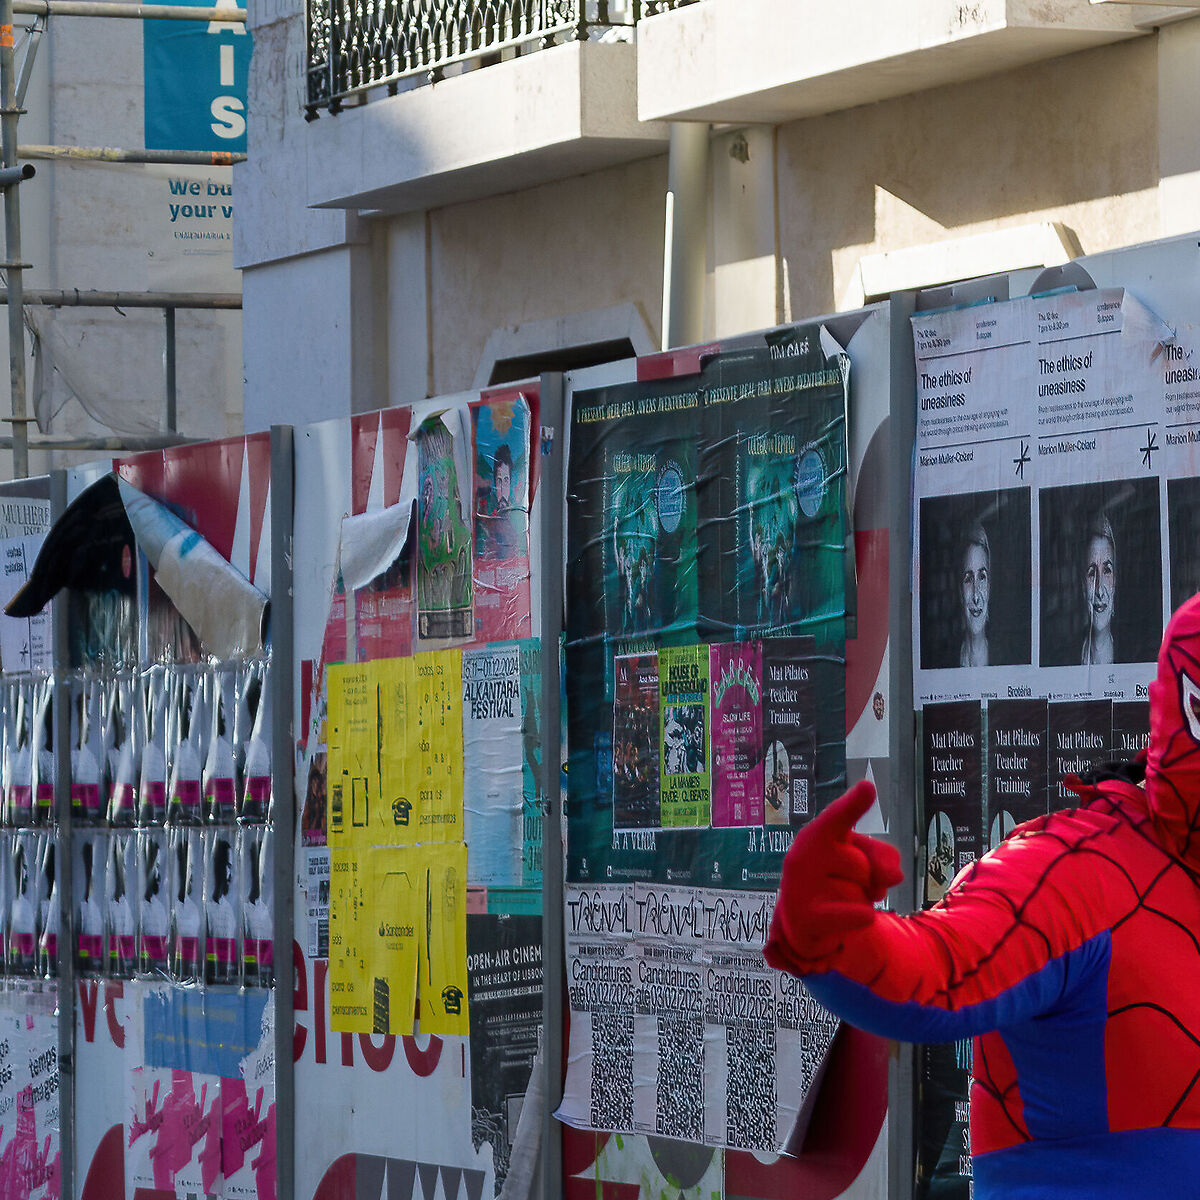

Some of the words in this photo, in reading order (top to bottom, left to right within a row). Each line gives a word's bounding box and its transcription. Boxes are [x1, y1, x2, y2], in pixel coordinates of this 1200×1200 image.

[168, 177, 200, 196] We
[169, 203, 216, 222] your
[1166, 344, 1183, 361] The
[1038, 357, 1055, 374] The
[1057, 354, 1082, 373] ethics
[1084, 351, 1093, 368] of
[921, 373, 937, 390] The
[938, 369, 963, 388] ethics
[963, 367, 972, 384] of
[1038, 377, 1086, 398] uneasiness
[921, 392, 966, 411] uneasiness
[1166, 432, 1187, 445] Marion
[1038, 443, 1056, 456] Marion
[769, 666, 784, 682] Mat
[785, 665, 809, 681] Pilates
[463, 680, 519, 701] ALKANTARA
[769, 687, 798, 703] Teacher
[471, 699, 514, 719] FESTIVAL
[769, 709, 800, 726] Training
[931, 731, 946, 748] Mat
[948, 730, 975, 748] Pilates
[995, 730, 1011, 746] Mat
[1012, 728, 1040, 746] Pilates
[1057, 732, 1074, 750] Mat
[1075, 731, 1103, 749] Pilates
[1120, 733, 1139, 750] Mat
[931, 754, 964, 772] Teacher
[995, 752, 1028, 770] Teacher
[1057, 755, 1092, 774] Teacher
[931, 777, 966, 798] Training
[995, 777, 1031, 799] Training
[467, 949, 511, 971] OPEN-AIR
[480, 973, 492, 986] THE
[493, 971, 512, 985] HEART
[513, 970, 521, 982] OF
[572, 958, 631, 984] Candidaturas
[638, 960, 700, 990] Candidaturas
[707, 969, 772, 997] Candidaturas
